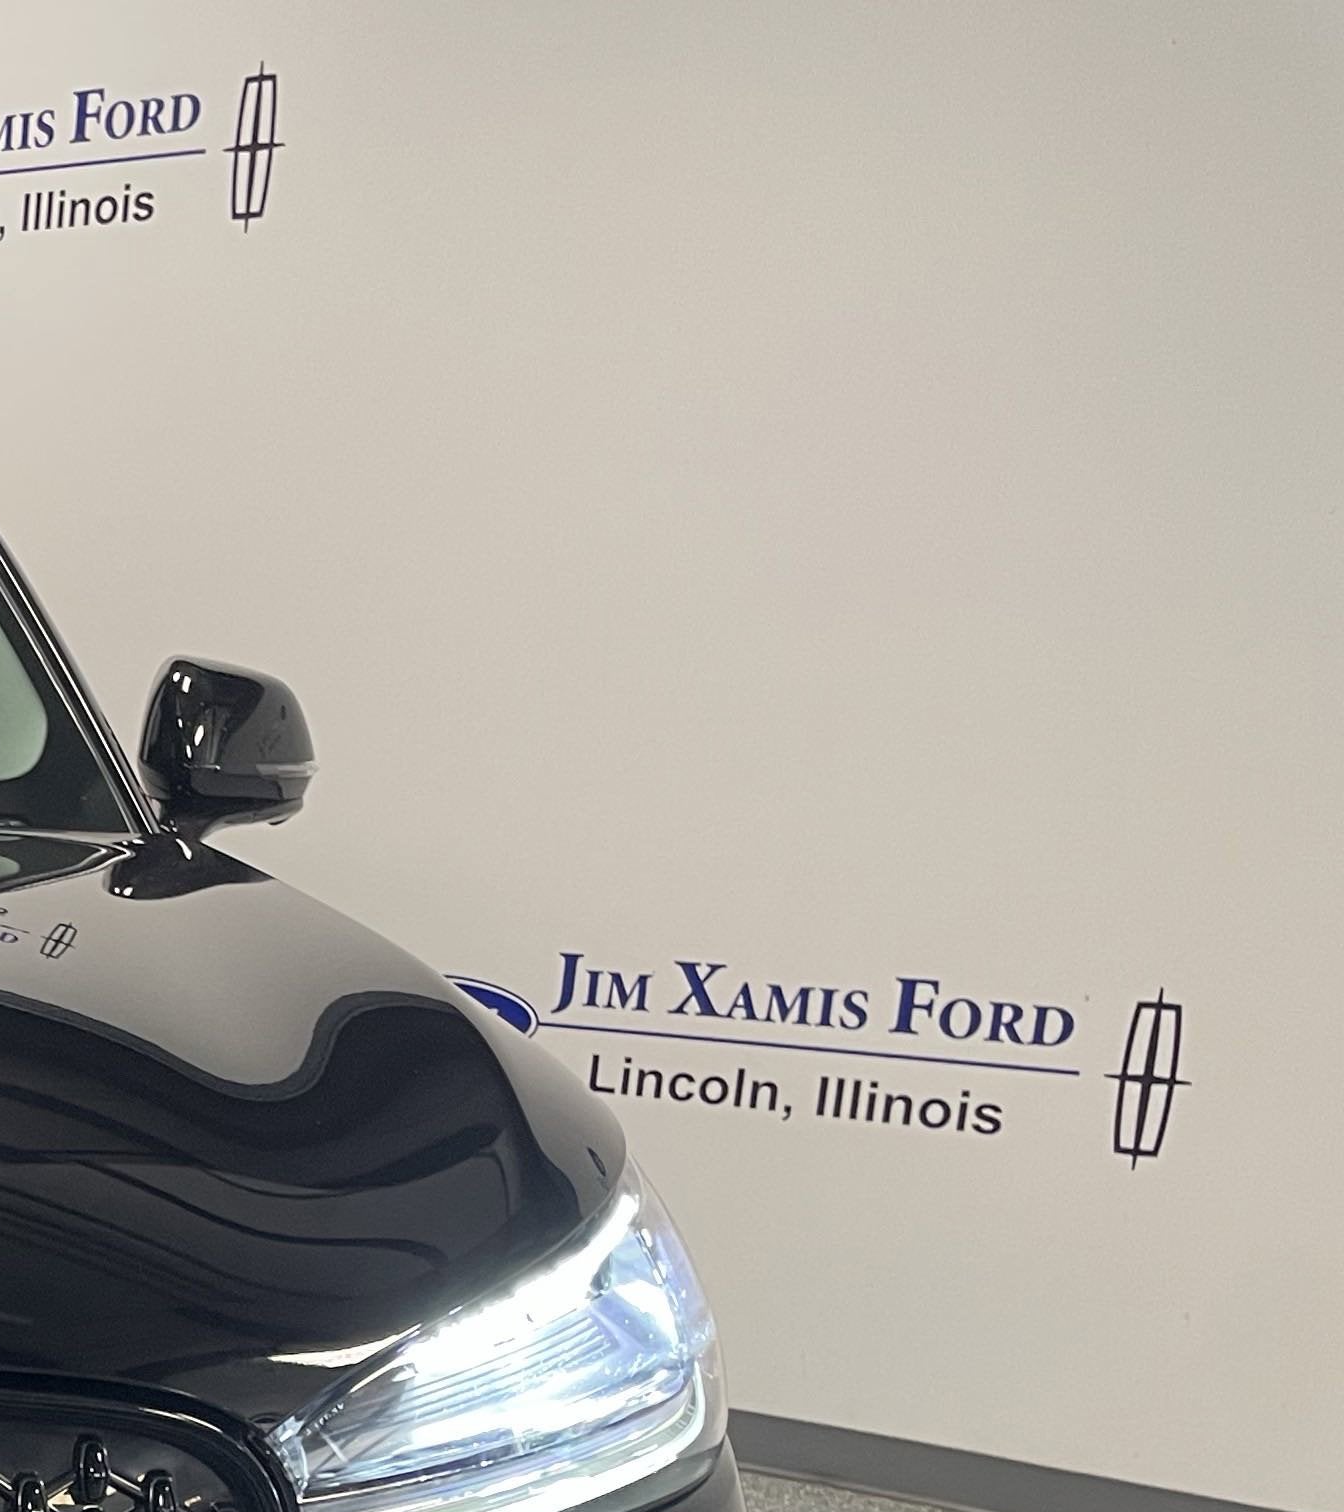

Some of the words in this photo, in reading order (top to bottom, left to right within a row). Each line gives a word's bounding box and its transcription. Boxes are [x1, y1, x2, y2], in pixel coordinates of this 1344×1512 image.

[70, 88, 201, 144] FORD
[21, 184, 155, 231] Illinois
[551, 952, 653, 1012] JIM
[668, 960, 869, 1031] XAMIS
[889, 977, 1075, 1047] FORD
[589, 1053, 793, 1121] Lincoln,
[816, 1076, 1003, 1136] Illinois
